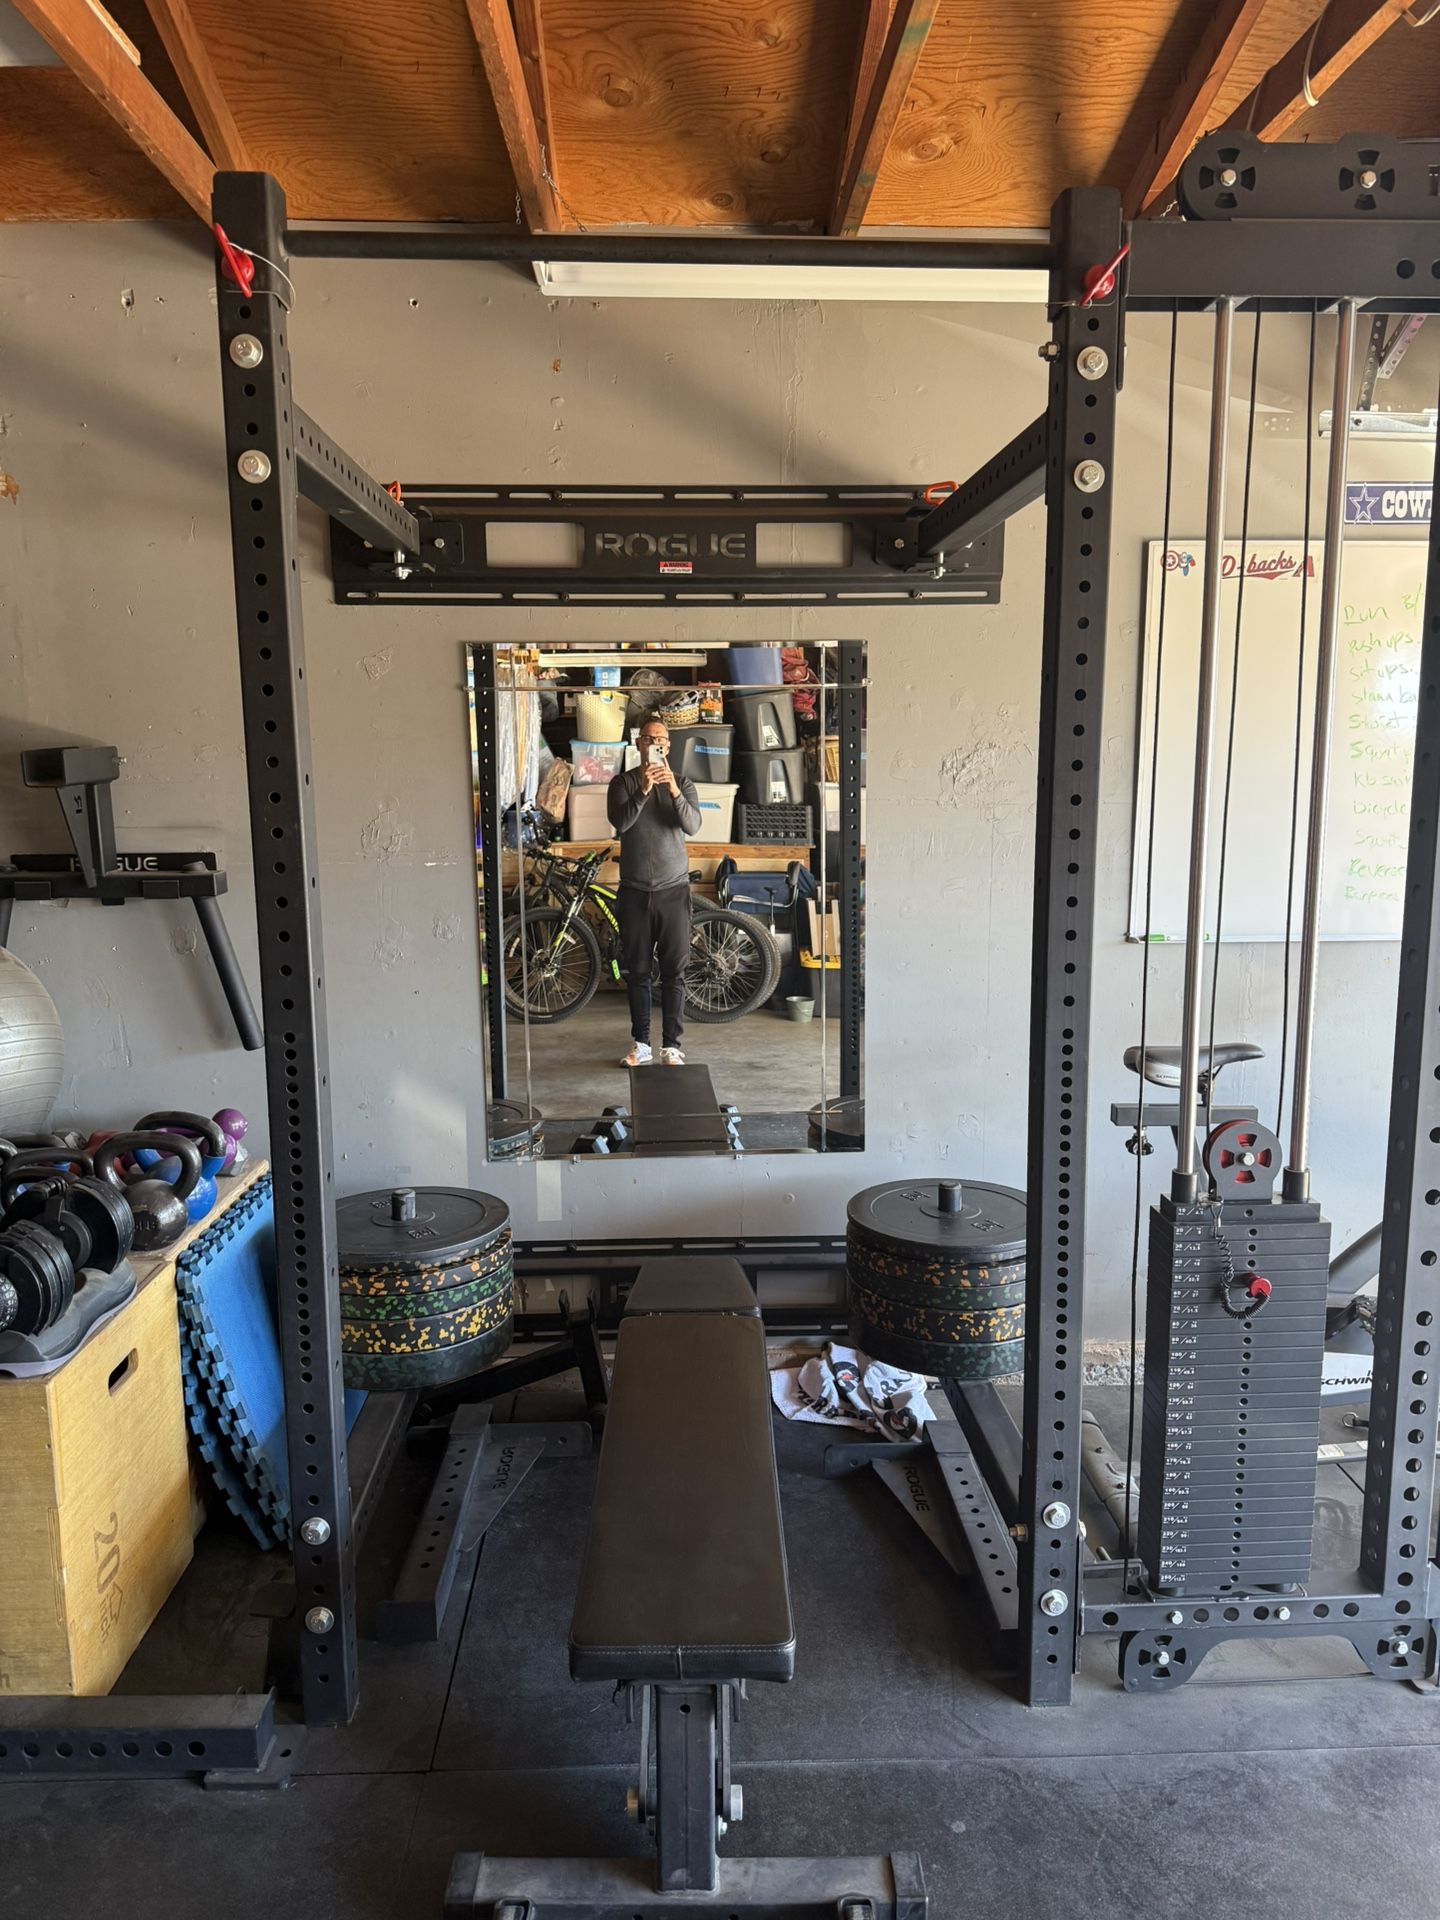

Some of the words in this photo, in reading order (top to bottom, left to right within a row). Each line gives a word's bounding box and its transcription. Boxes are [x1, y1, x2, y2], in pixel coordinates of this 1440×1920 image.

[1382, 490, 1432, 518] COW
[595, 533, 745, 558] ROGUE
[904, 1466, 930, 1512] ROGUE
[93, 1511, 121, 1594] 20
